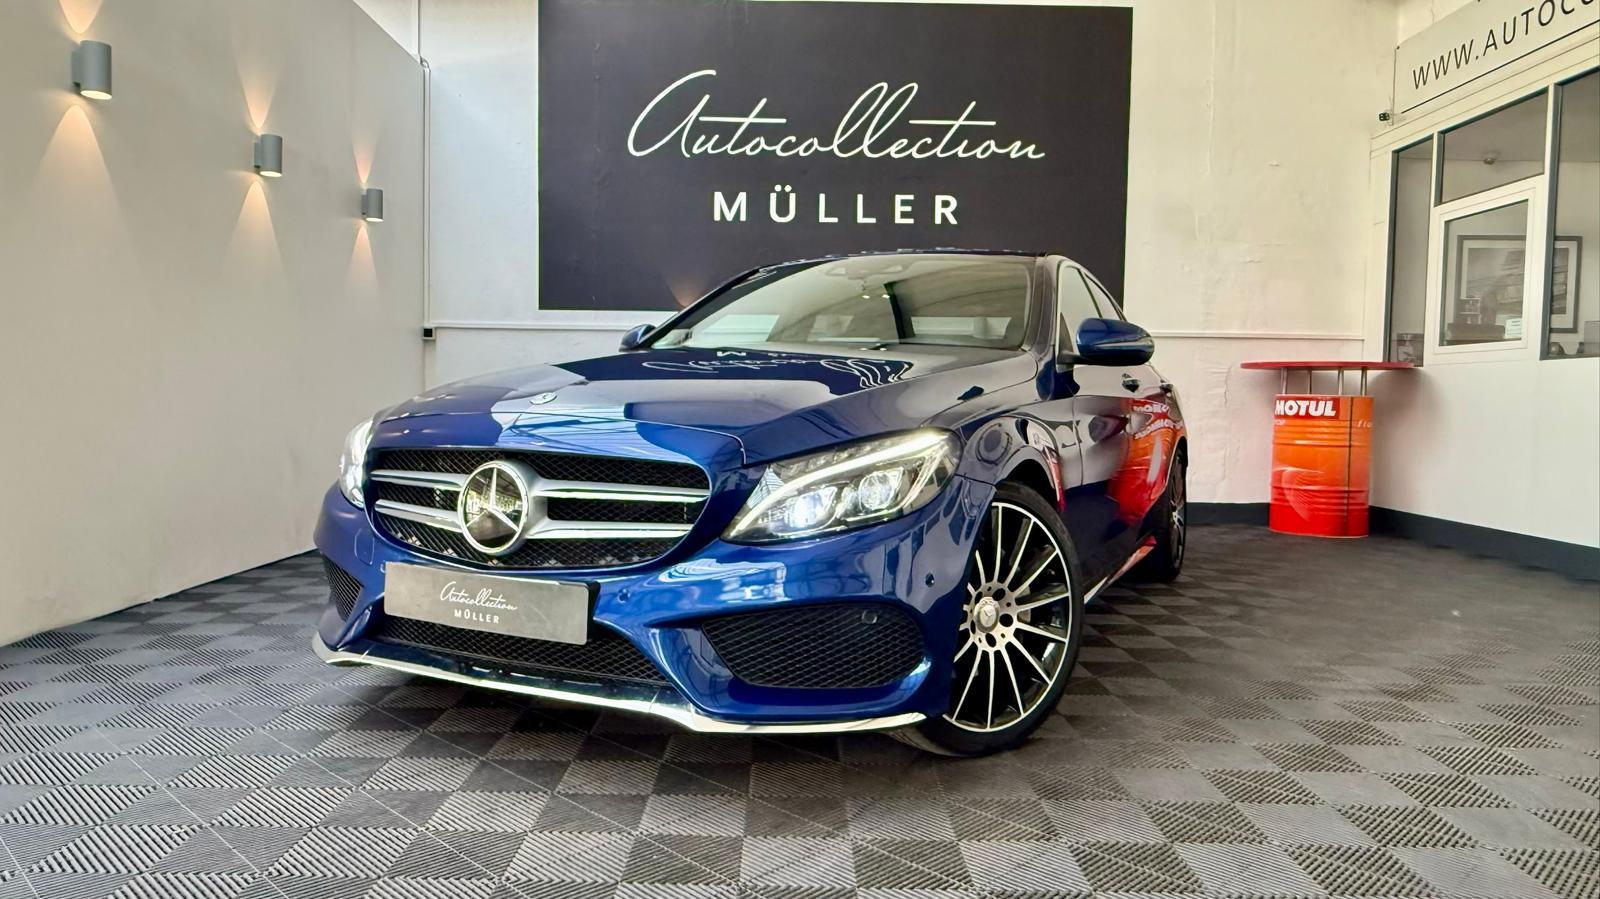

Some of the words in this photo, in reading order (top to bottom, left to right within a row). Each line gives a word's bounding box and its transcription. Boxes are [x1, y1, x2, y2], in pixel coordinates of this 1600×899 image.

[1412, 0, 1595, 90] WWW.AUTOC
[627, 69, 1046, 159] Autocollection
[713, 184, 958, 225] MÜLLER
[1275, 400, 1337, 417] MOTUL
[440, 582, 518, 611] Autocollection
